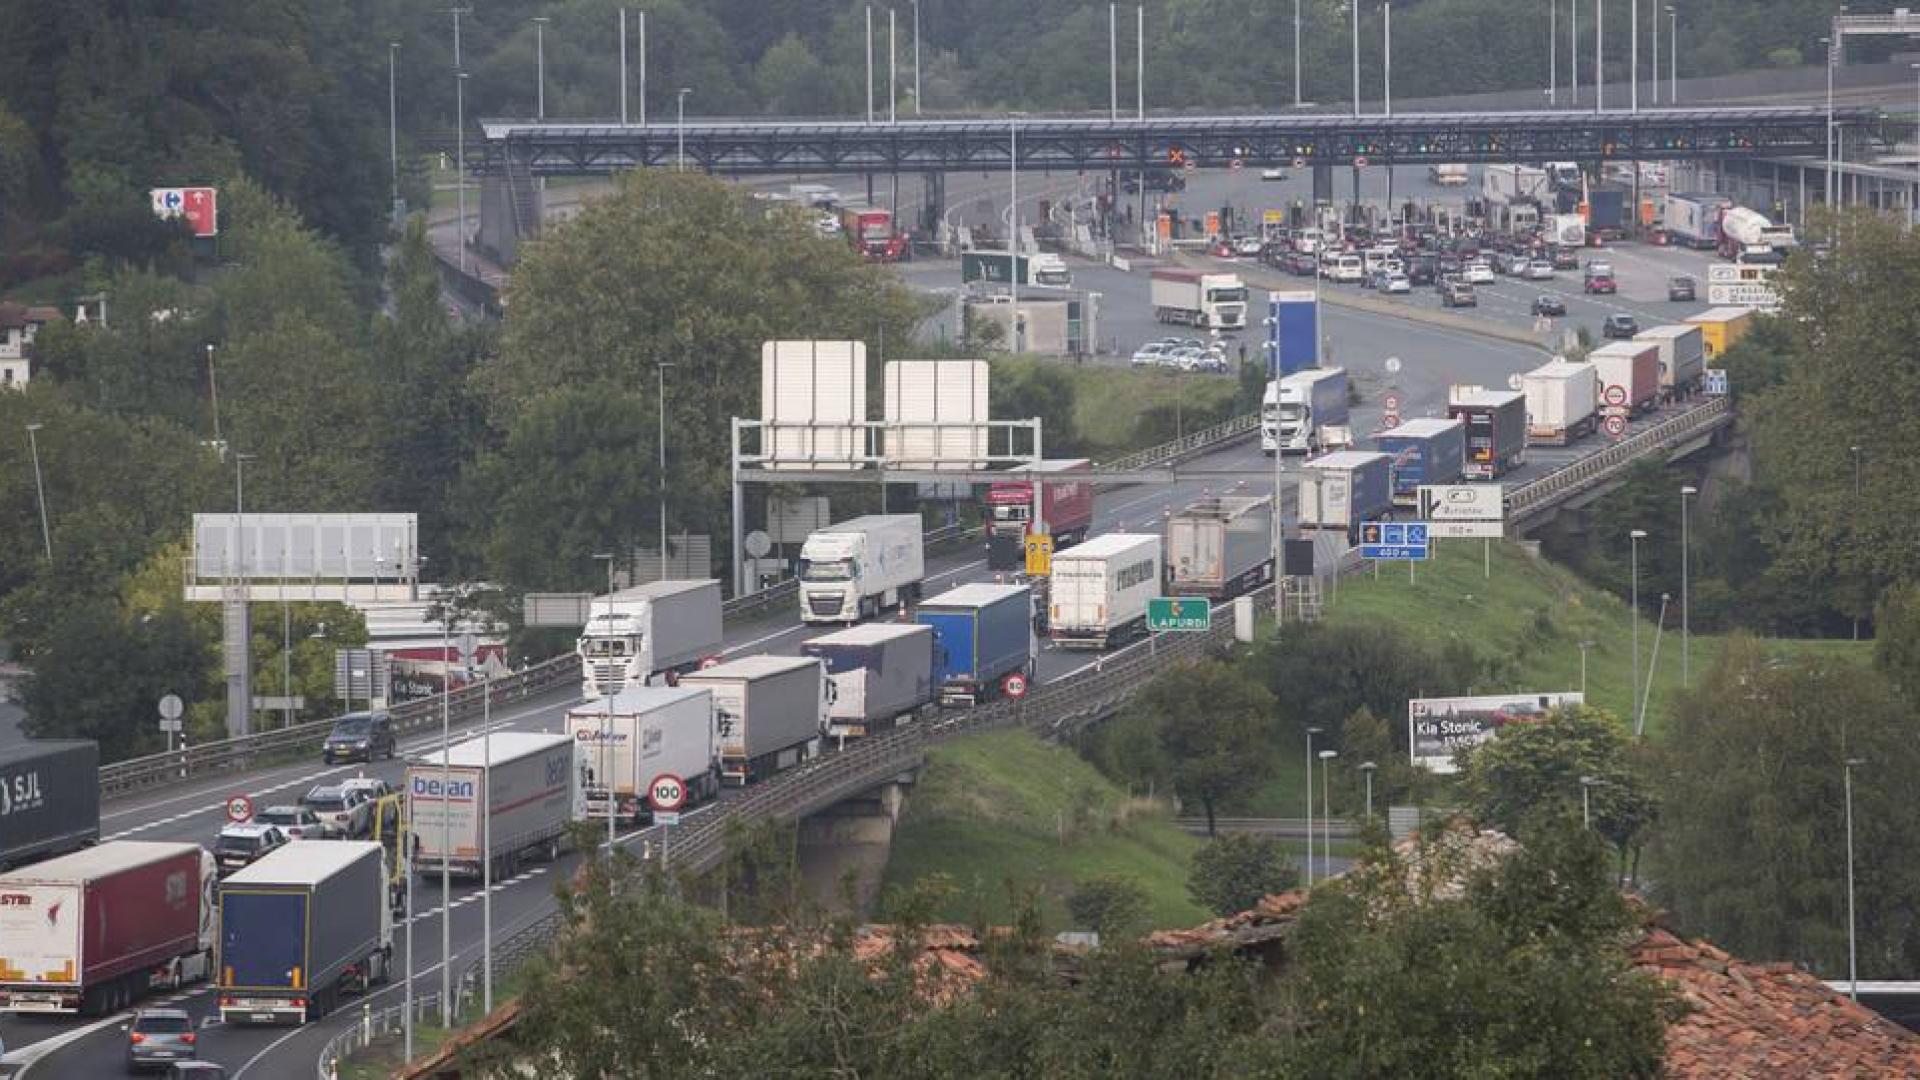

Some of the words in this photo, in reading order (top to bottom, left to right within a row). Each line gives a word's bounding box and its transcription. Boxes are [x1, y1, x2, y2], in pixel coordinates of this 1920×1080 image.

[1610, 421, 1625, 432] 70
[1151, 618, 1207, 630] LAPURDI
[1416, 721, 1438, 735] Kia
[1440, 720, 1482, 735] Stonic
[14, 771, 41, 802] SJL
[414, 776, 474, 797] beran
[655, 785, 680, 799] 100
